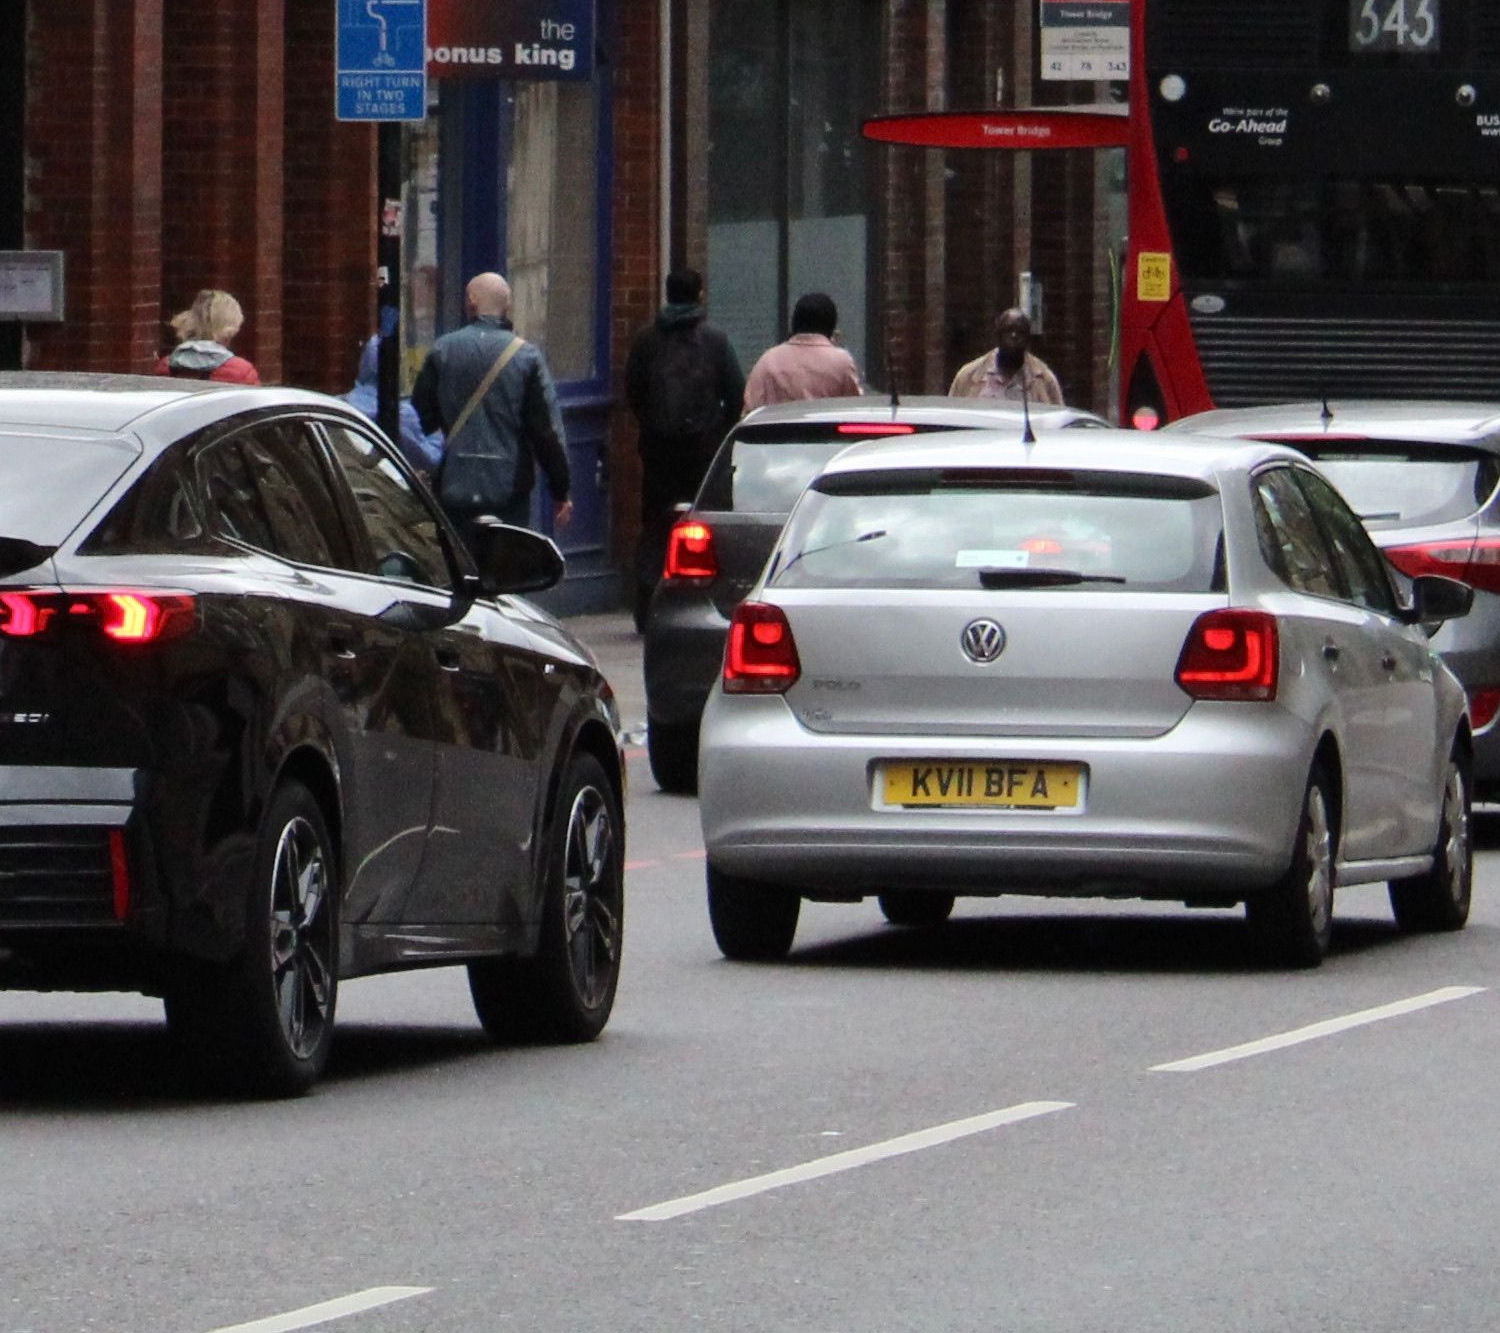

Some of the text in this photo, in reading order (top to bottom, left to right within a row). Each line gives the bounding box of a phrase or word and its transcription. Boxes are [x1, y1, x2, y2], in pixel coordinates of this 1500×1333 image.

[540, 18, 576, 41] the
[515, 43, 576, 71] king
[342, 76, 421, 89] RIGHT TURN
[357, 90, 405, 102] IN TWO
[355, 103, 406, 115] STAGES
[1207, 118, 1287, 134] Go-Ahead
[1476, 115, 1500, 127] BUS
[982, 124, 1051, 138] Tower Bridge
[911, 767, 1049, 799] KV11 BFA
